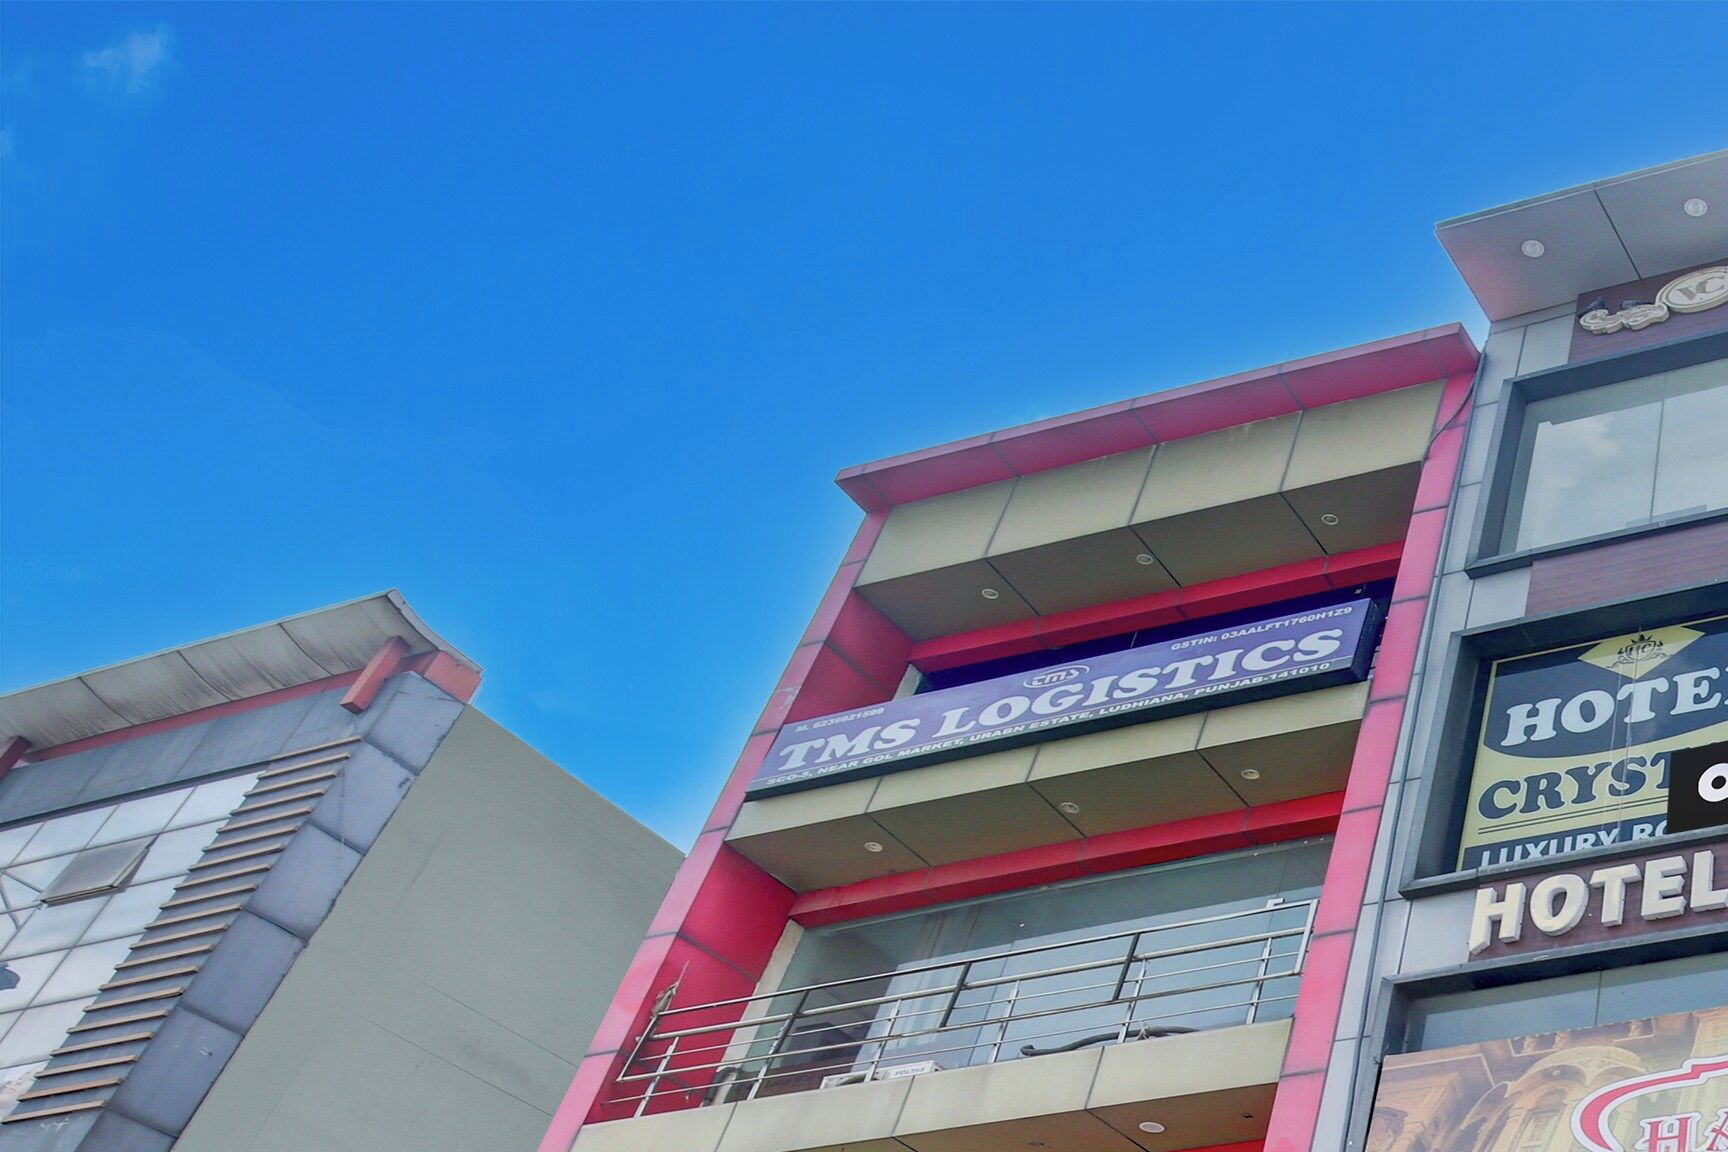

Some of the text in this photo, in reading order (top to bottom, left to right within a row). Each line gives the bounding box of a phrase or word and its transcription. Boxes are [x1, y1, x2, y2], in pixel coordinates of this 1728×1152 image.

[777, 627, 1344, 772] TMS LOGISTICS
[817, 759, 860, 775] NEAR
[862, 753, 894, 765] GOL
[897, 739, 965, 758] MARKET,
[1028, 711, 1094, 730] ESTATE,
[1098, 691, 1189, 716] LUDHIANA,
